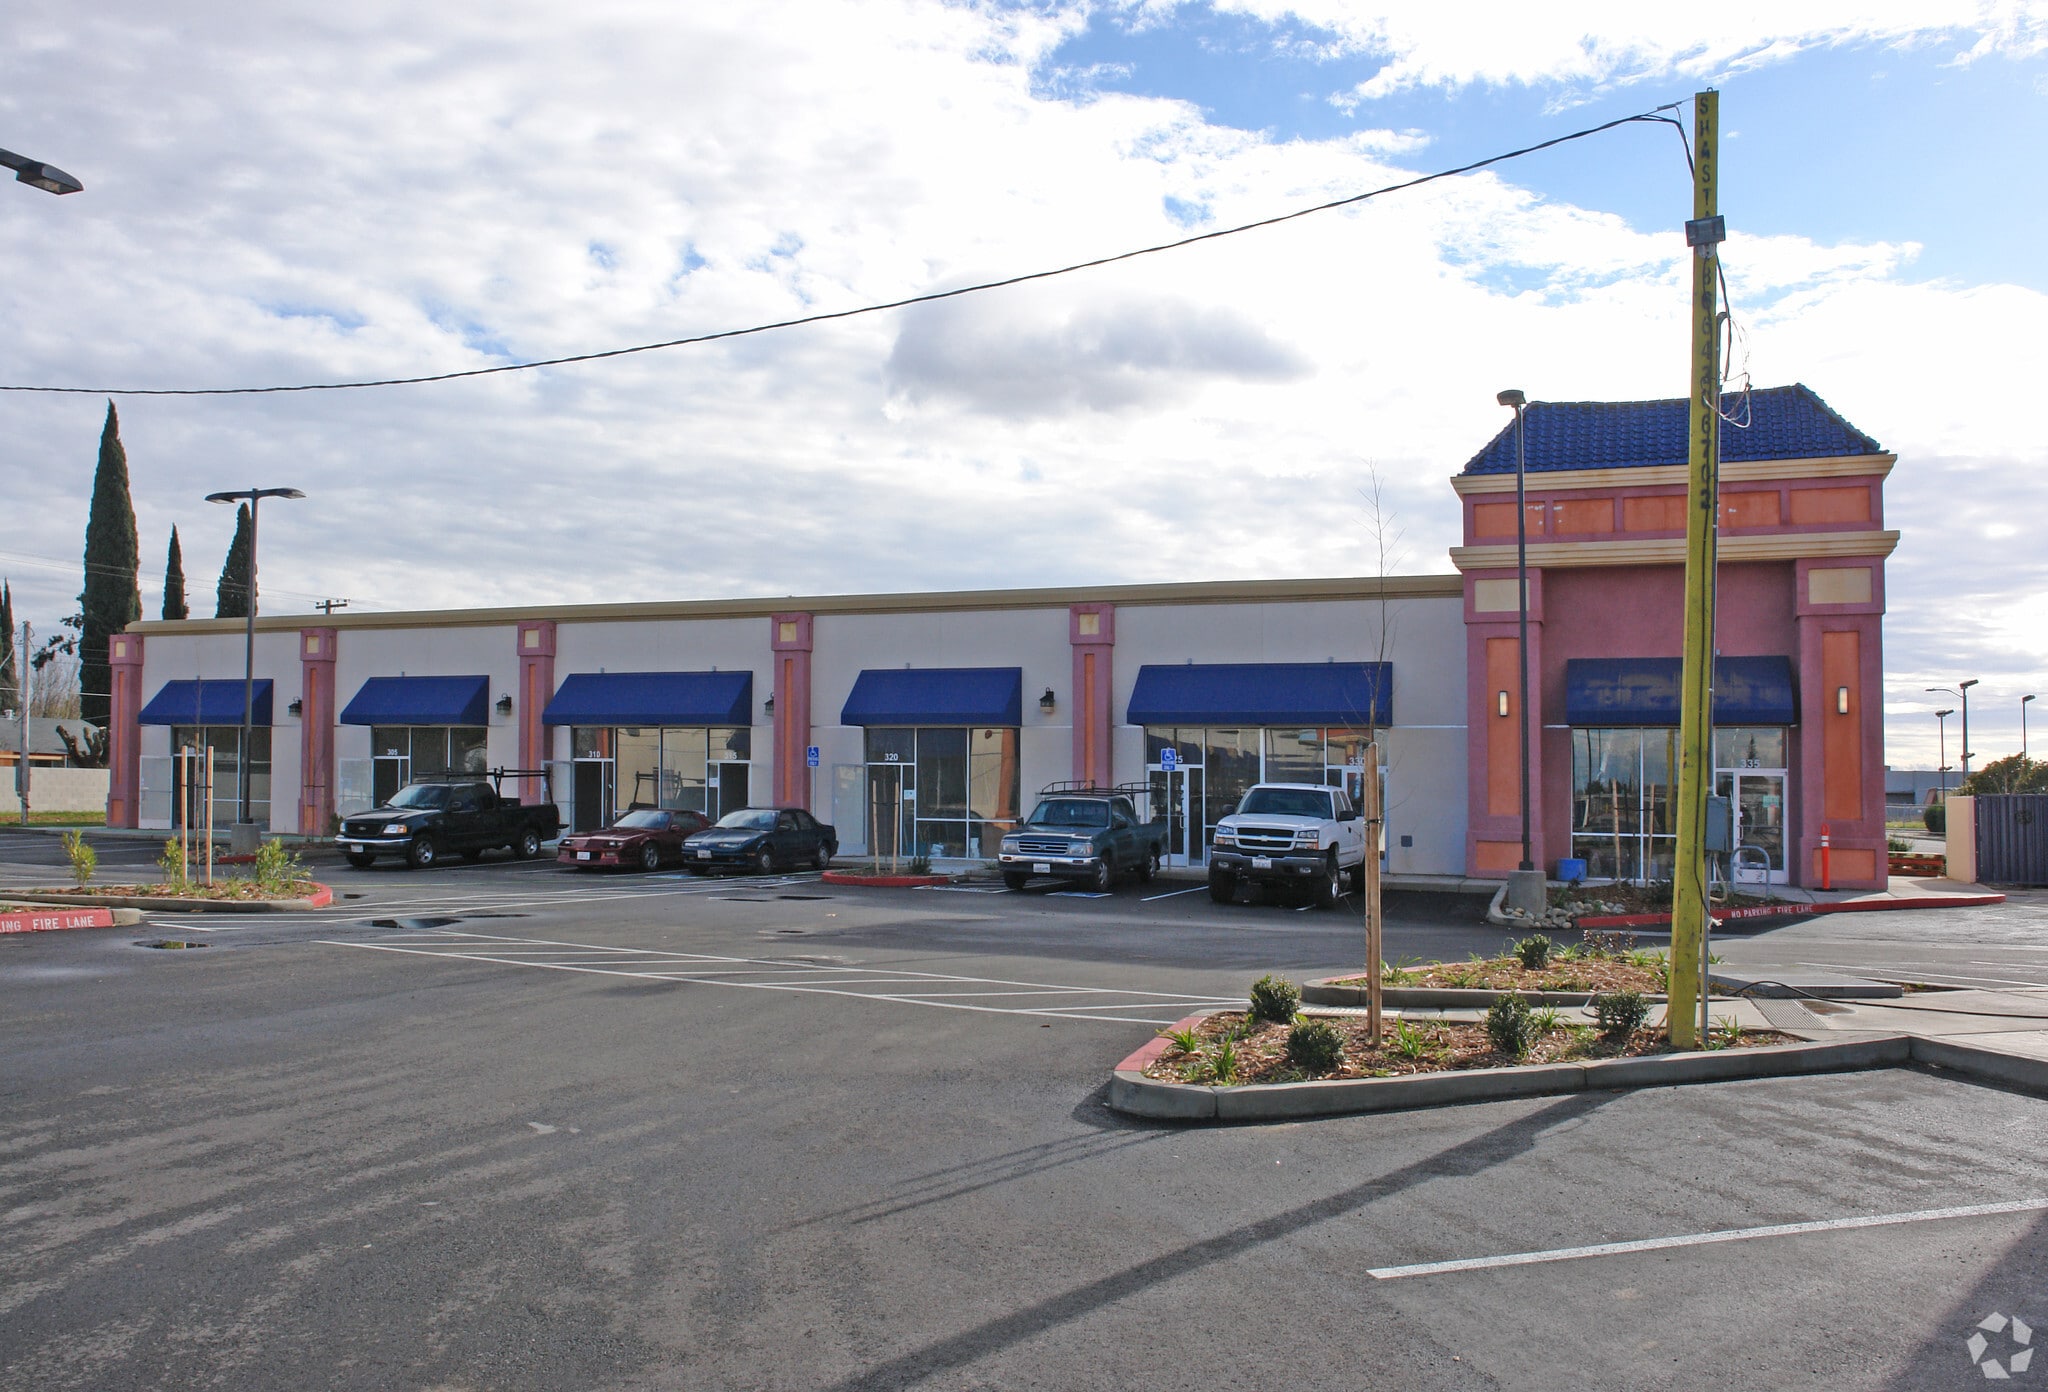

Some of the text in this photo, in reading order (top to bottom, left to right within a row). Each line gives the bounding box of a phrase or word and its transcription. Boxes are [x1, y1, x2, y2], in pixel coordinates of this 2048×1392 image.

[588, 750, 601, 758] 310
[885, 752, 899, 761] 320
[1741, 759, 1760, 768] 335
[1731, 904, 1814, 919] NO PARKING FIRE LANE
[0, 915, 95, 932] ING FIRE LANE
